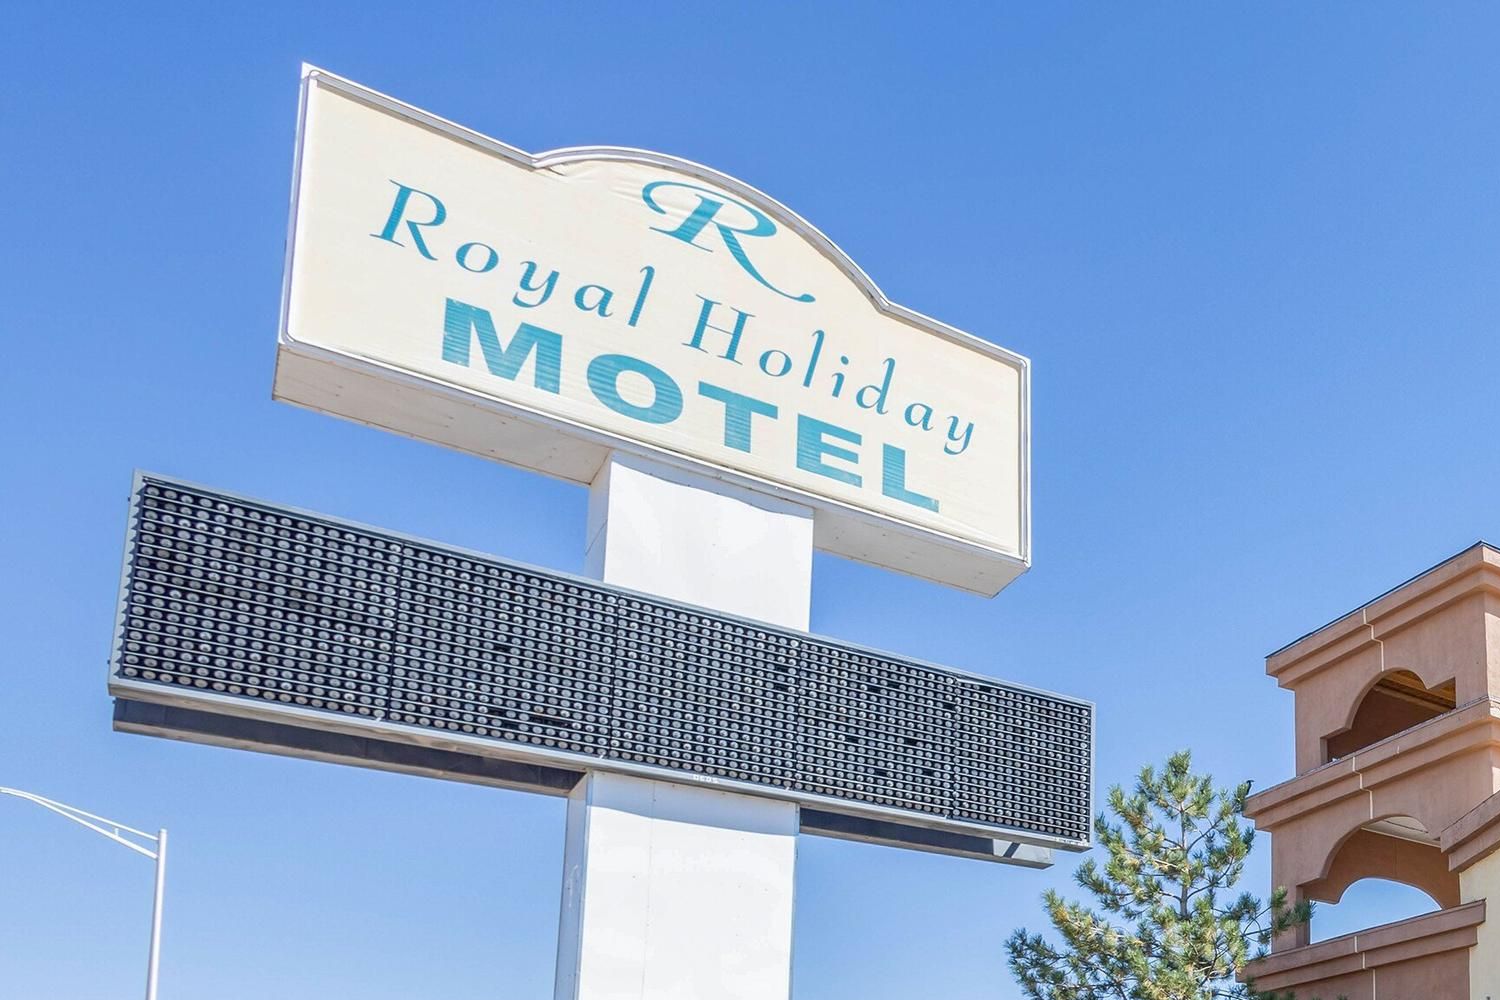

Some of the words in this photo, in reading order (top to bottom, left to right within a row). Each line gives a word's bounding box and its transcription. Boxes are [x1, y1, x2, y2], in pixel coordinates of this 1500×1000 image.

[369, 179, 655, 327] Royal
[682, 294, 974, 455] Holiday
[642, 180, 815, 304] R
[442, 297, 939, 513] MOTEL
